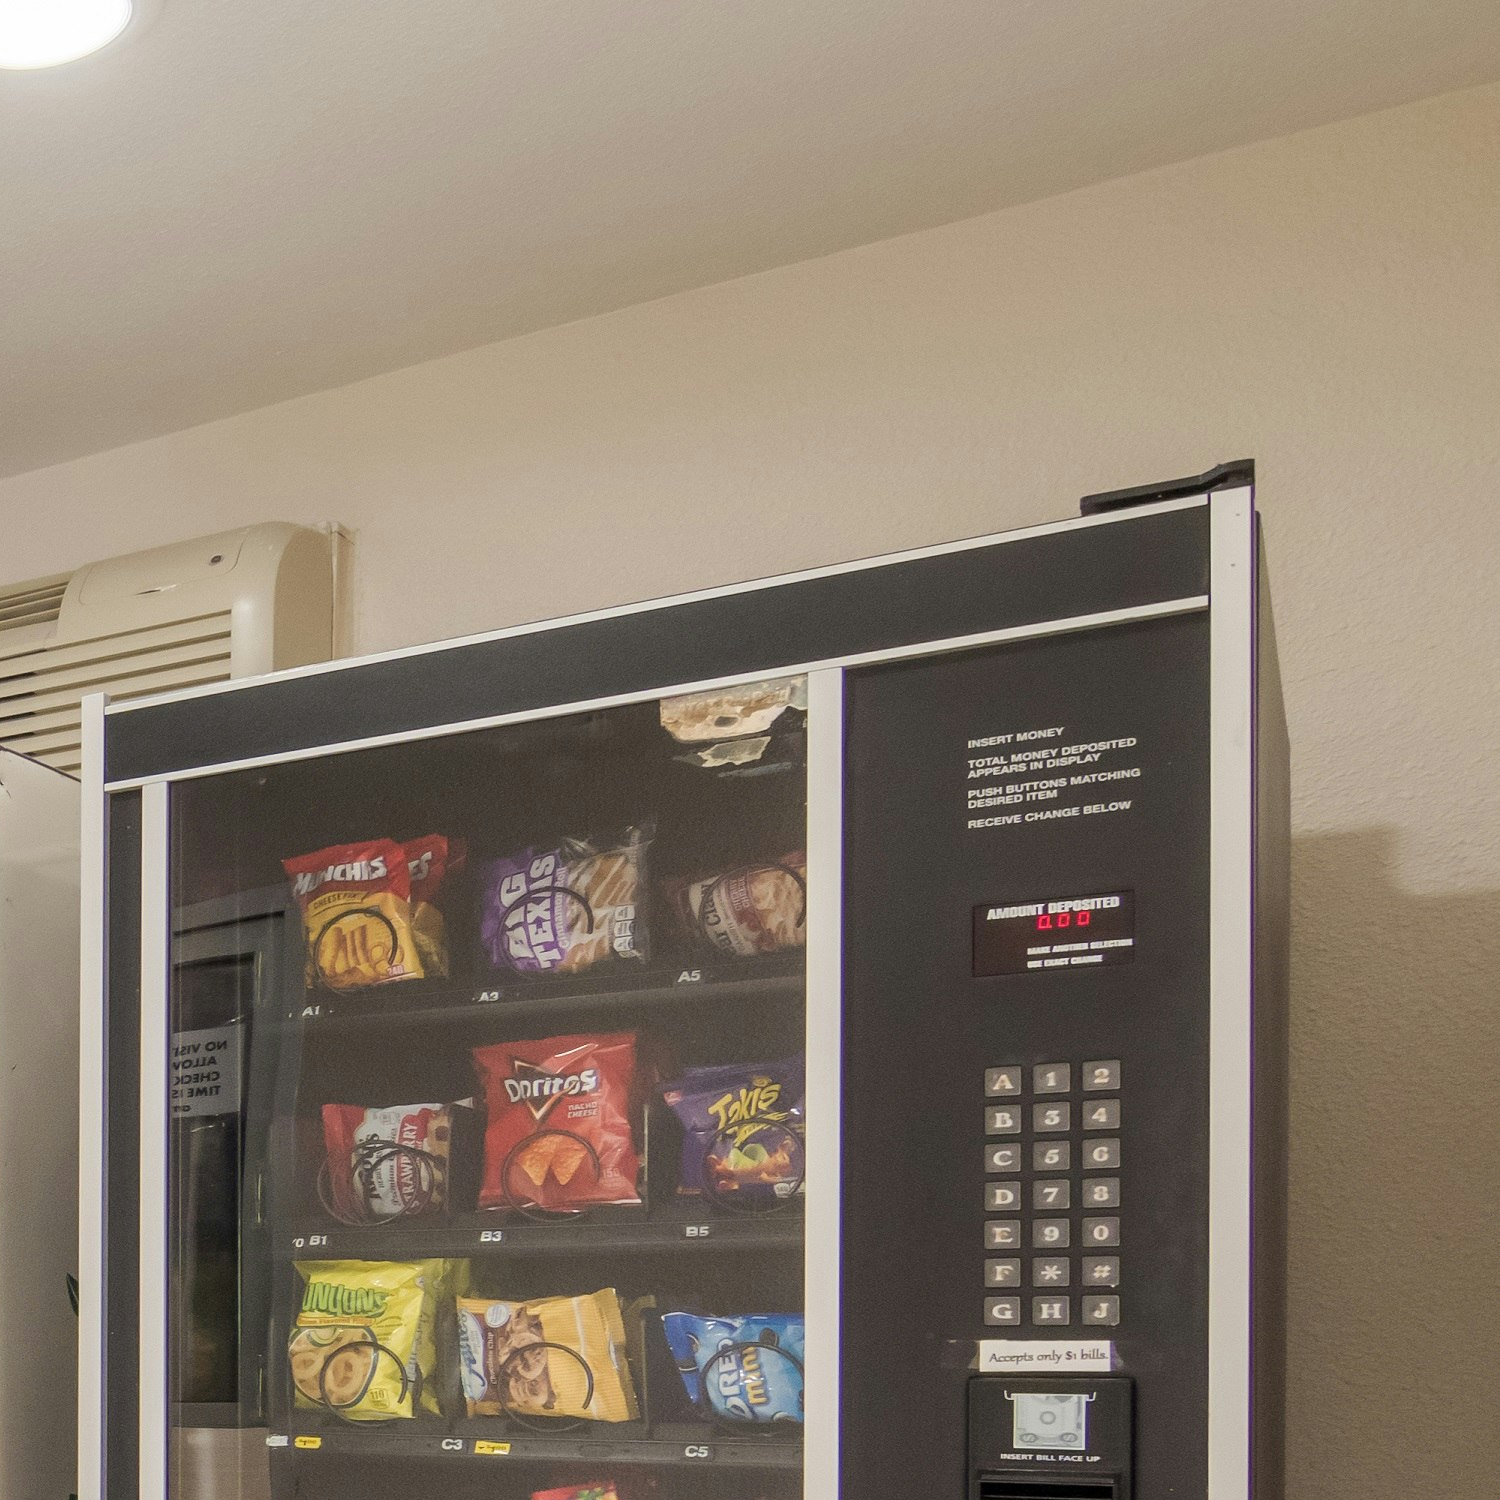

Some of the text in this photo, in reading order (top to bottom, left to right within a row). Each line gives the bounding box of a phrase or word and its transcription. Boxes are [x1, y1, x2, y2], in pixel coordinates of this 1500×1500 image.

[967, 727, 1064, 749] INSERT MONEY
[967, 737, 1137, 769] TOTAL MONEY DEPOSITED
[967, 753, 1101, 779] APPEARS IN DISPLAY
[967, 768, 1141, 799] PUSH BUTTONS MATCHING
[967, 789, 1058, 809] DESIRED ITEM
[967, 800, 1132, 829] RECEIVE CHANGE BELOW
[986, 896, 1120, 921] AMOUNT DEPOSITED
[677, 970, 701, 983] A5
[478, 991, 499, 1002] A3
[302, 1005, 320, 1017] A1
[993, 1075, 1014, 1090] A
[1046, 1072, 1056, 1086] 1
[1094, 1069, 1109, 1083] 2
[504, 1069, 597, 1103] Doritos
[568, 1101, 598, 1110] NACHO
[708, 1081, 782, 1142] Takis
[567, 1109, 599, 1118] CHEESE
[995, 1113, 1012, 1127] B
[1045, 1111, 1059, 1125] 3
[1092, 1108, 1106, 1122] 4
[993, 1151, 1012, 1165] C
[1045, 1149, 1059, 1163] 5
[1093, 1147, 1108, 1161] 6
[995, 1190, 1013, 1204] D
[1044, 1188, 1058, 1202] 7
[1094, 1186, 1108, 1200] 8
[480, 1231, 502, 1242] B3
[685, 1226, 710, 1237] B5
[994, 1228, 1012, 1242] E
[1044, 1227, 1059, 1241] 9
[1094, 1226, 1108, 1240] 0
[309, 1235, 328, 1246] B1
[995, 1266, 1013, 1280] F
[993, 1304, 1012, 1318] G
[1041, 1304, 1061, 1318] H
[1094, 1303, 1108, 1318] J
[989, 1348, 1109, 1365] Accepts only $1 bills.
[441, 1439, 463, 1450] C3
[685, 1446, 709, 1458] C5
[1000, 1453, 1034, 1461] INSERT
